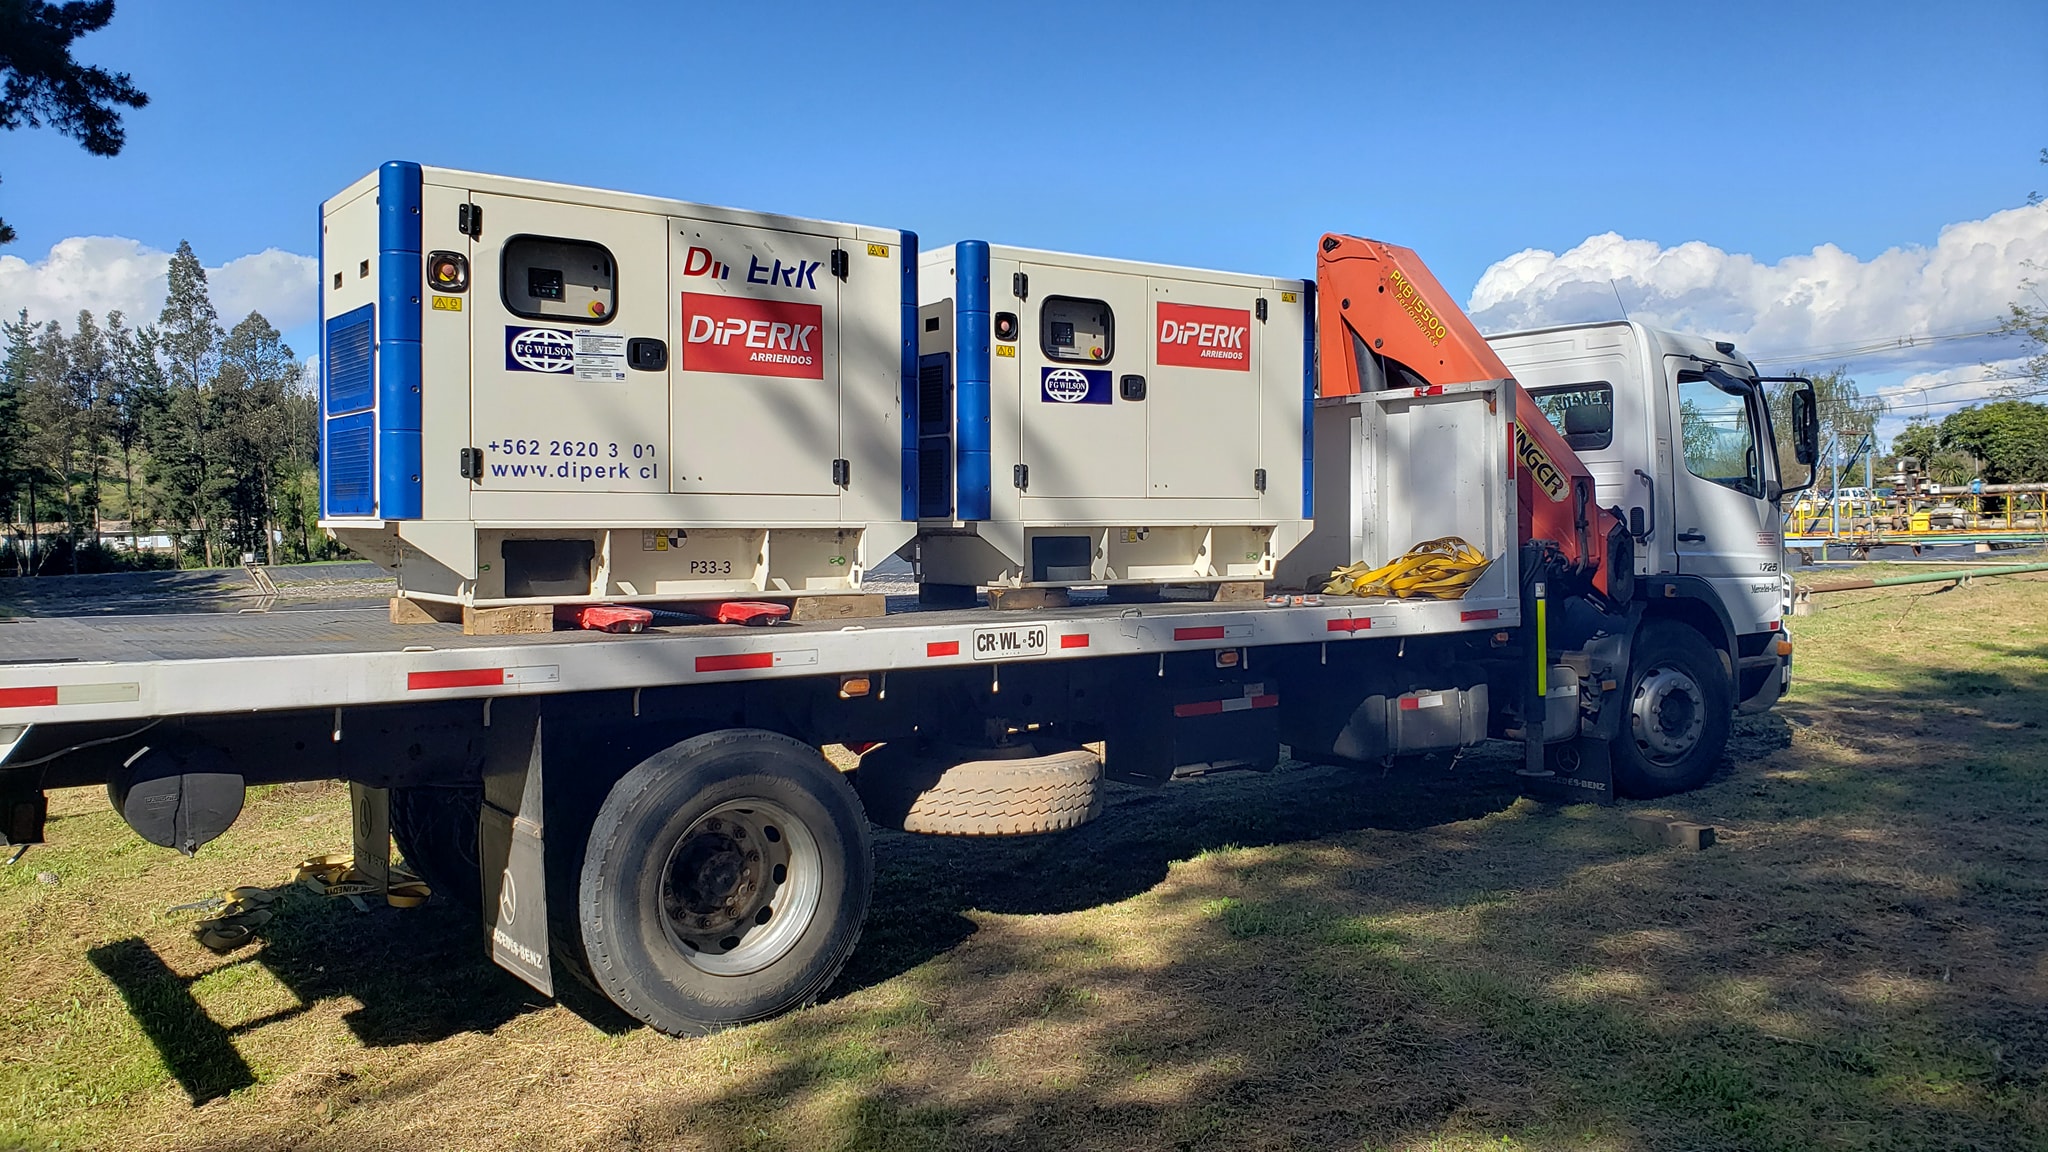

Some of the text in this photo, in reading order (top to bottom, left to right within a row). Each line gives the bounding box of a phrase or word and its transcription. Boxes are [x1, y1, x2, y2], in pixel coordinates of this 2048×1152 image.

[1390, 270, 1446, 338] PKB 15500
[1395, 293, 1439, 346] Performance
[750, 352, 812, 365] ARRIENDOS
[1200, 349, 1243, 360] ARRIENDOS
[1060, 381, 1085, 390] WILSON
[488, 439, 540, 455] +562
[549, 441, 598, 457] 2620
[690, 561, 731, 574] P33-3
